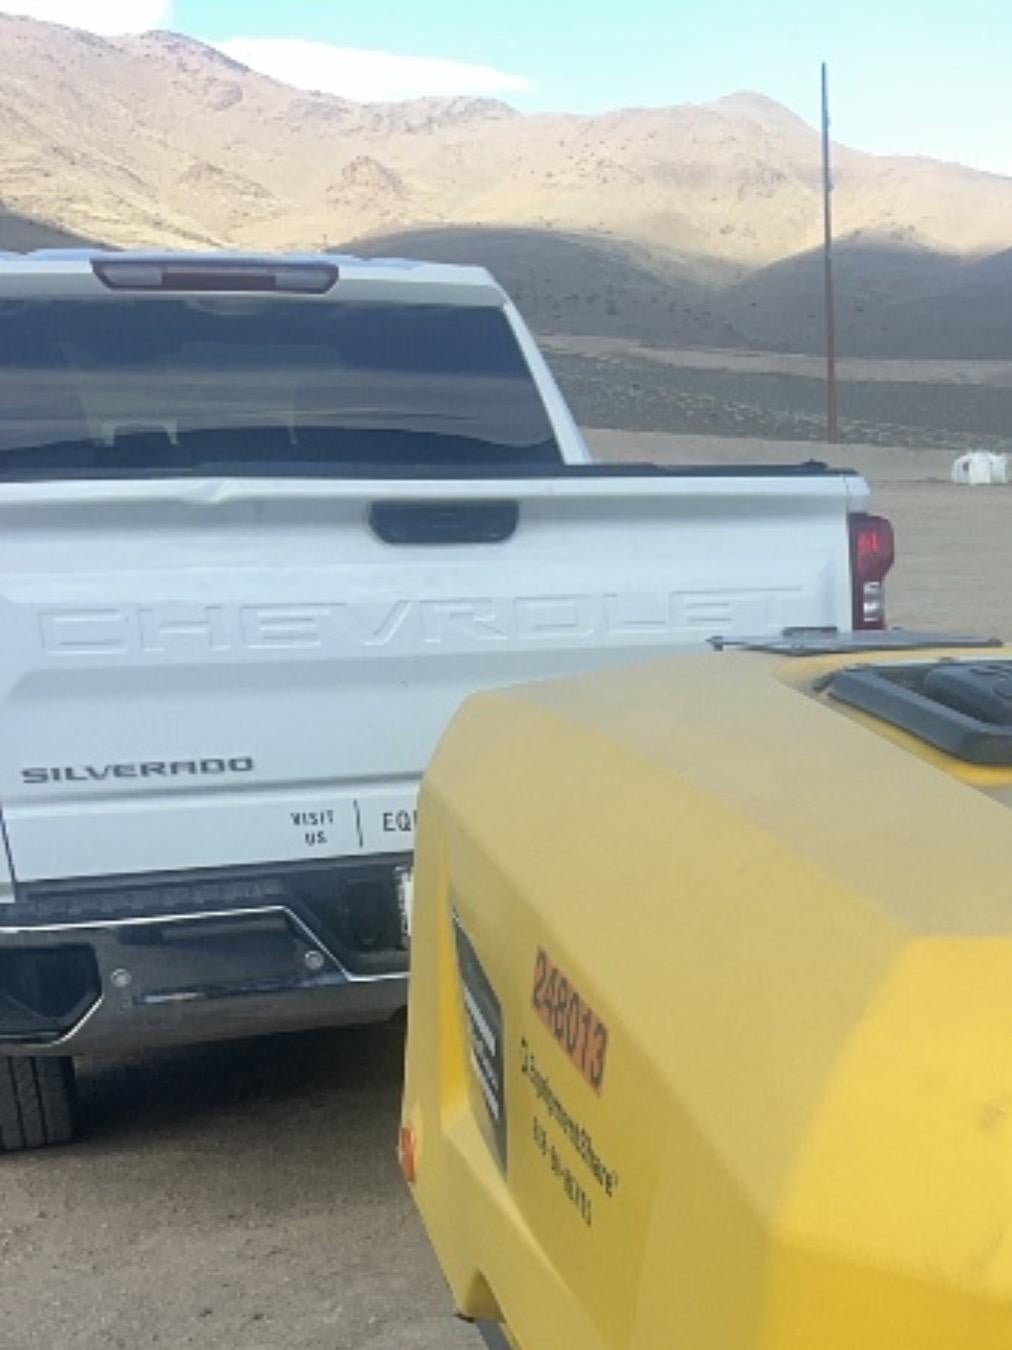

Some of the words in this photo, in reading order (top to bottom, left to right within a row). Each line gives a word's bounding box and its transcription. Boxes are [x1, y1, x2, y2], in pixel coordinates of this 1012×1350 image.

[40, 588, 804, 656] CHEVROLET
[21, 756, 255, 784] SILVERADO
[290, 809, 335, 827] VISIT
[305, 831, 328, 846] US
[533, 949, 608, 1090] 248013
